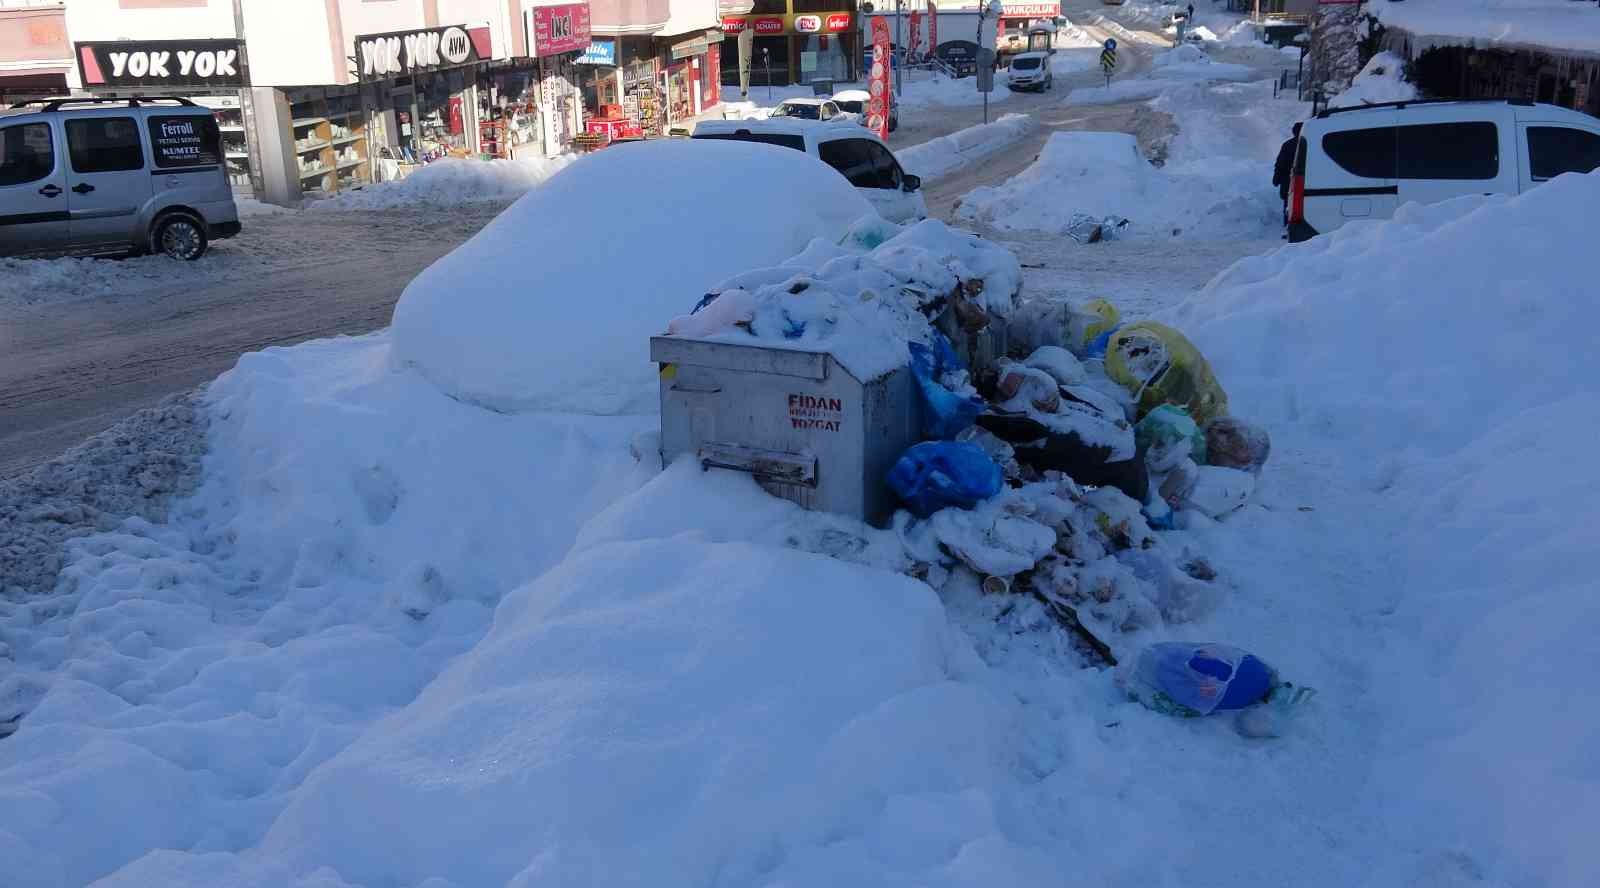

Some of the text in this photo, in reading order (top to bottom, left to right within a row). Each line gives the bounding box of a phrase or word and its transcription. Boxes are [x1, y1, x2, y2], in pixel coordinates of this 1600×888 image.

[109, 49, 237, 78] YOK YOK
[361, 31, 466, 75] YOK YOK AVM
[788, 392, 842, 412] FİDAN
